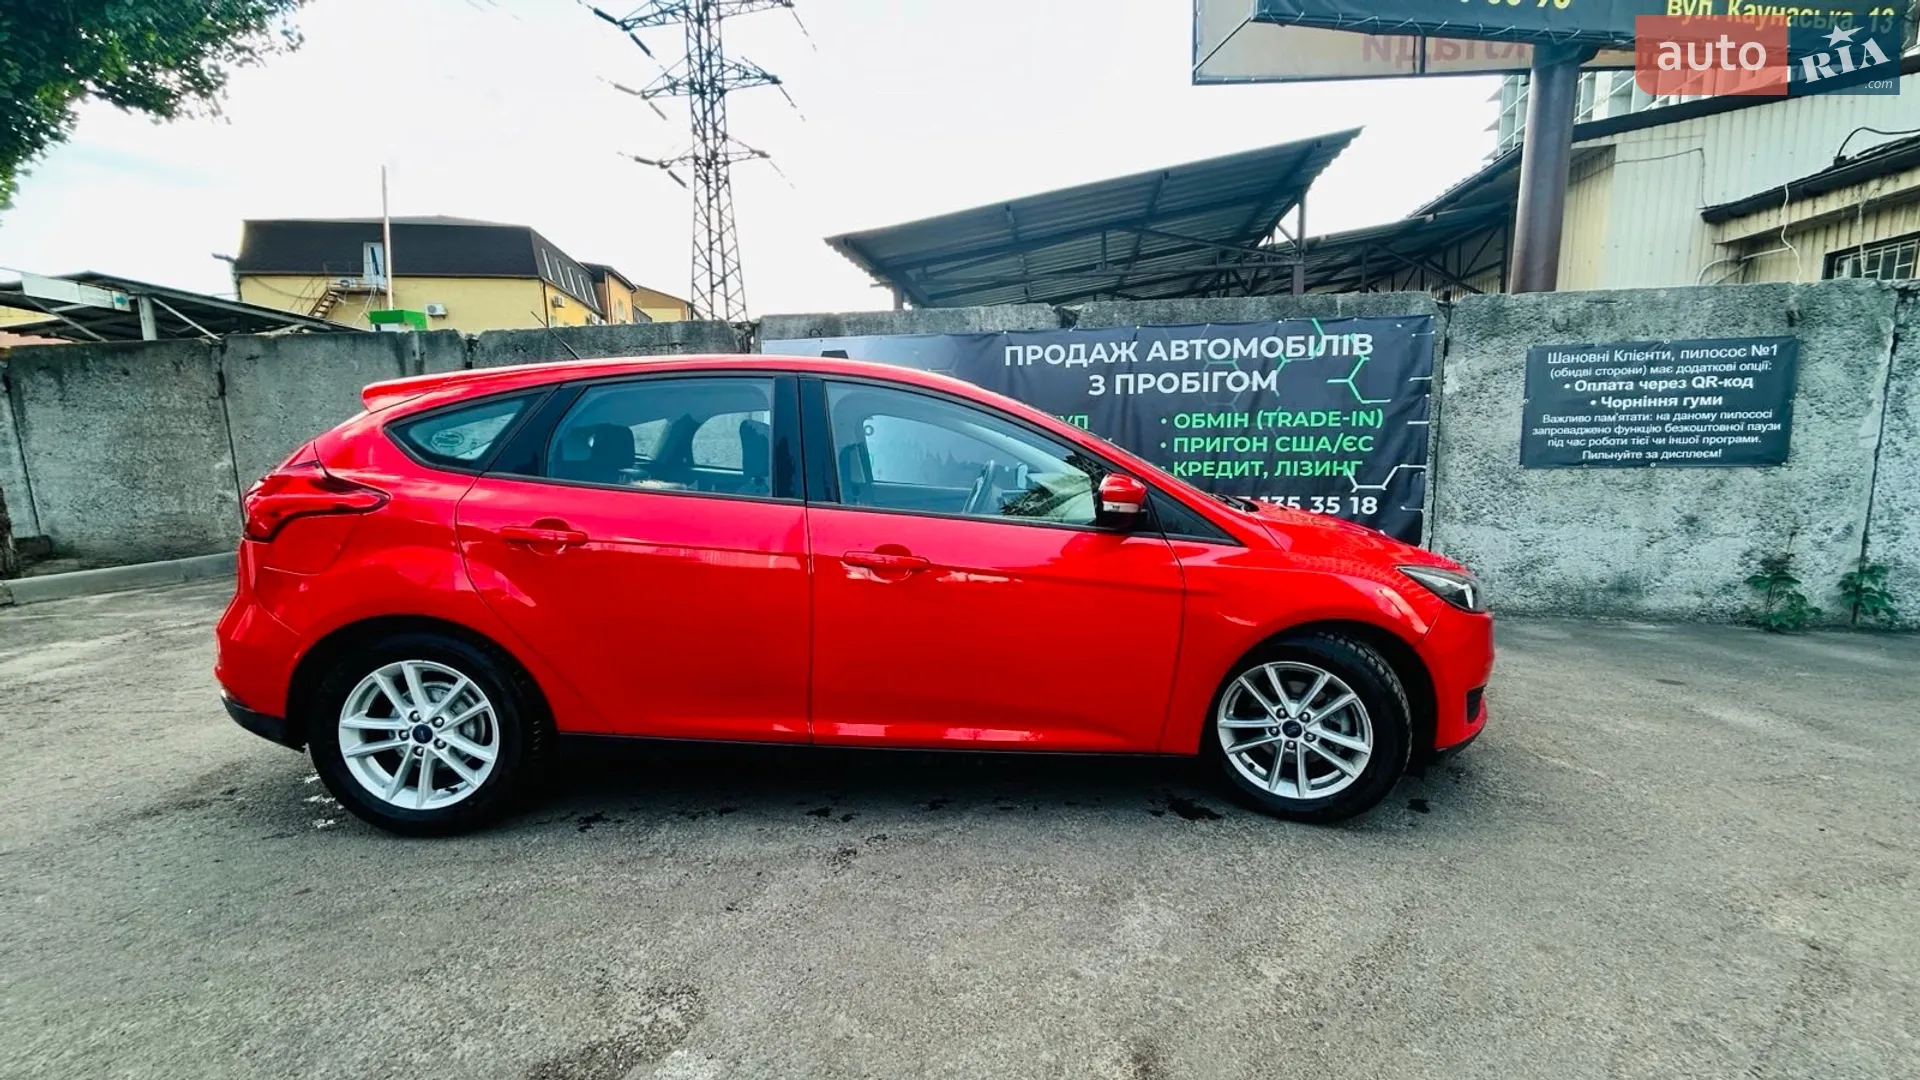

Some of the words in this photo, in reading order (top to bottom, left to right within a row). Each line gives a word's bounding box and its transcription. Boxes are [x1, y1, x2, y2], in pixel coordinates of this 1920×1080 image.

[1868, 6, 1896, 34] 13
[1004, 340, 1138, 368] ПРОДАЖ
[1146, 333, 1374, 363] АВТОМОБІЛІВ
[1547, 350, 1610, 364] Шановні
[1614, 348, 1675, 362] Клієнти,
[1680, 347, 1747, 359] пилосос
[1751, 344, 1778, 356] №1
[1550, 367, 1592, 380] (обидві
[1595, 365, 1647, 377] сторони)
[1650, 365, 1673, 374] має
[1675, 362, 1737, 375] додаткові
[1115, 369, 1278, 395] ПРОБІГОМ
[1574, 379, 1635, 392] Оплата
[1639, 379, 1687, 393] через
[1691, 376, 1754, 389] QR-код
[1601, 395, 1679, 410] Чорніння
[1682, 395, 1724, 409] гуми
[1173, 412, 1250, 429] ОБМІН
[1256, 408, 1384, 430] (TRADE-IN)
[1542, 414, 1592, 424] Важливо
[1656, 413, 1670, 421] на
[1672, 412, 1717, 422] даному
[1719, 409, 1773, 420] пилососі
[1532, 426, 1612, 437] запроваджено
[1614, 424, 1662, 436] функцію
[1664, 422, 1745, 433] безкоштовної
[1747, 422, 1781, 433] паузи
[1173, 436, 1267, 453] ПРИГОН
[1275, 433, 1375, 454] США/ЄС
[1547, 437, 1564, 448] під
[1566, 438, 1586, 447] час
[1588, 436, 1628, 447] роботи
[1652, 437, 1666, 445] чи
[1668, 435, 1699, 445] іншої
[1702, 435, 1762, 446] програми.
[1582, 449, 1643, 461] Пильнуйте
[1645, 451, 1659, 459] за
[1660, 448, 1723, 460] дисплеєм!
[1173, 460, 1269, 479] КРЕДИТ,
[1274, 459, 1363, 477] ЛІЗИНГ
[1310, 496, 1340, 514] 35
[1350, 496, 1378, 515] 18
